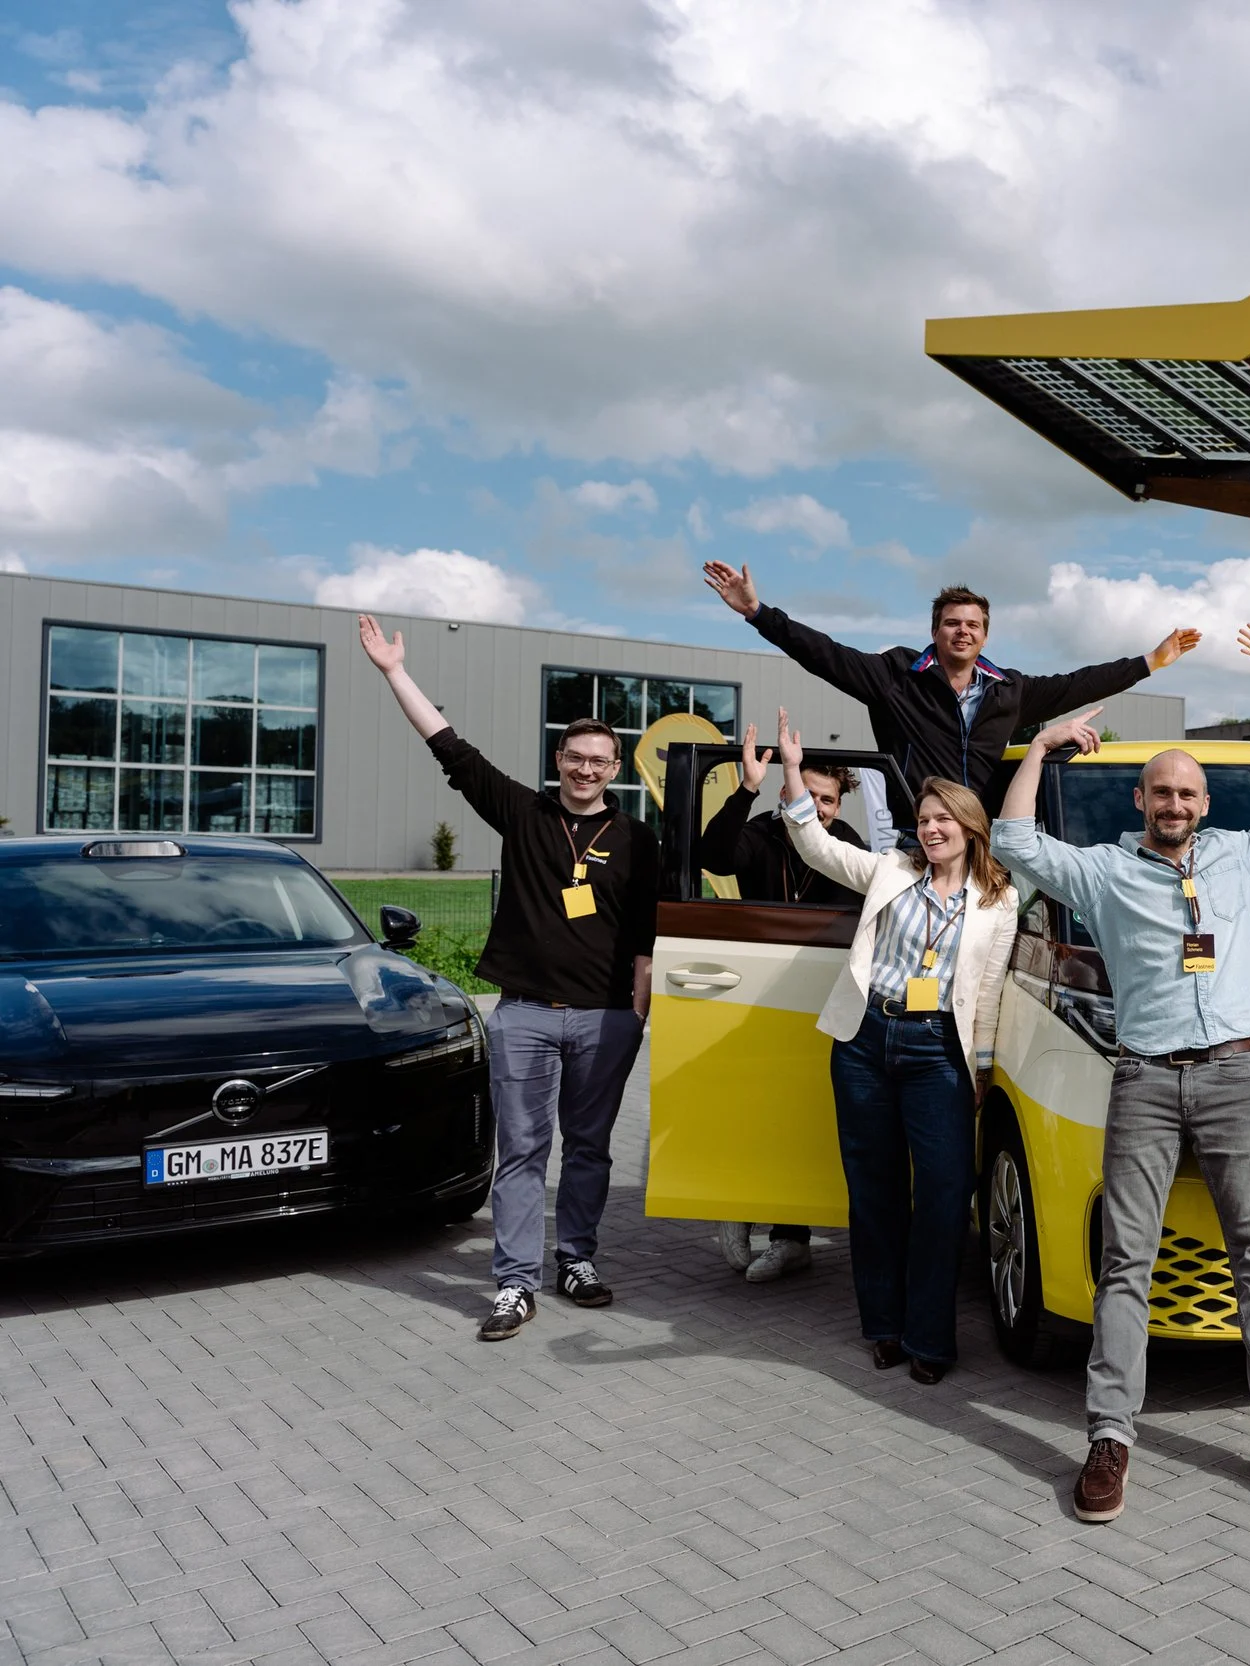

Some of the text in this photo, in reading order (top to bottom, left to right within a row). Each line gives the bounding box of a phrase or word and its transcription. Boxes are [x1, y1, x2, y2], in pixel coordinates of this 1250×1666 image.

[152, 1137, 323, 1178] D GM MA 837E
